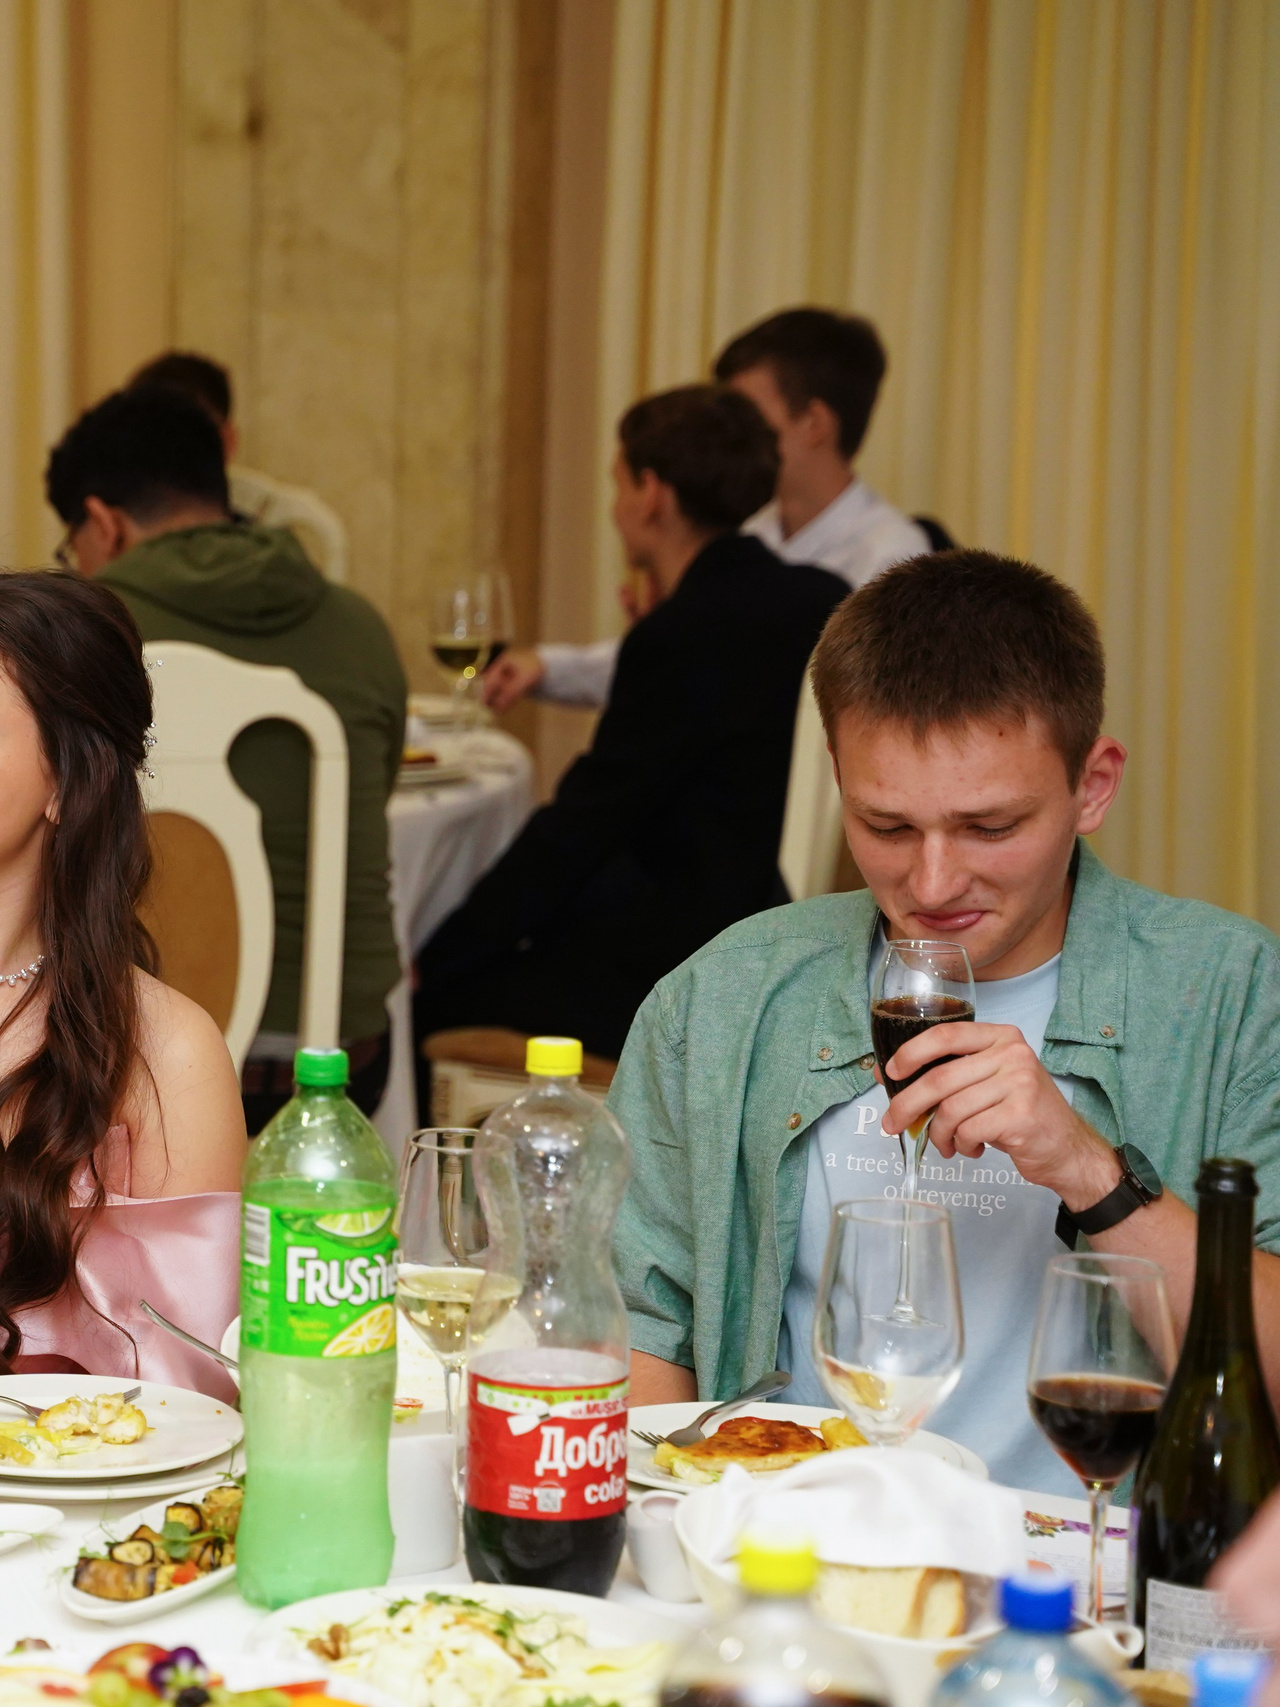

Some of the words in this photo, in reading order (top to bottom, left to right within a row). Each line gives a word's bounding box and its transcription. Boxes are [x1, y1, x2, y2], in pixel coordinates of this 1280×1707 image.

[825, 1152, 838, 1168] a
[920, 1156, 964, 1182] inal
[917, 1188, 1007, 1217] revenge
